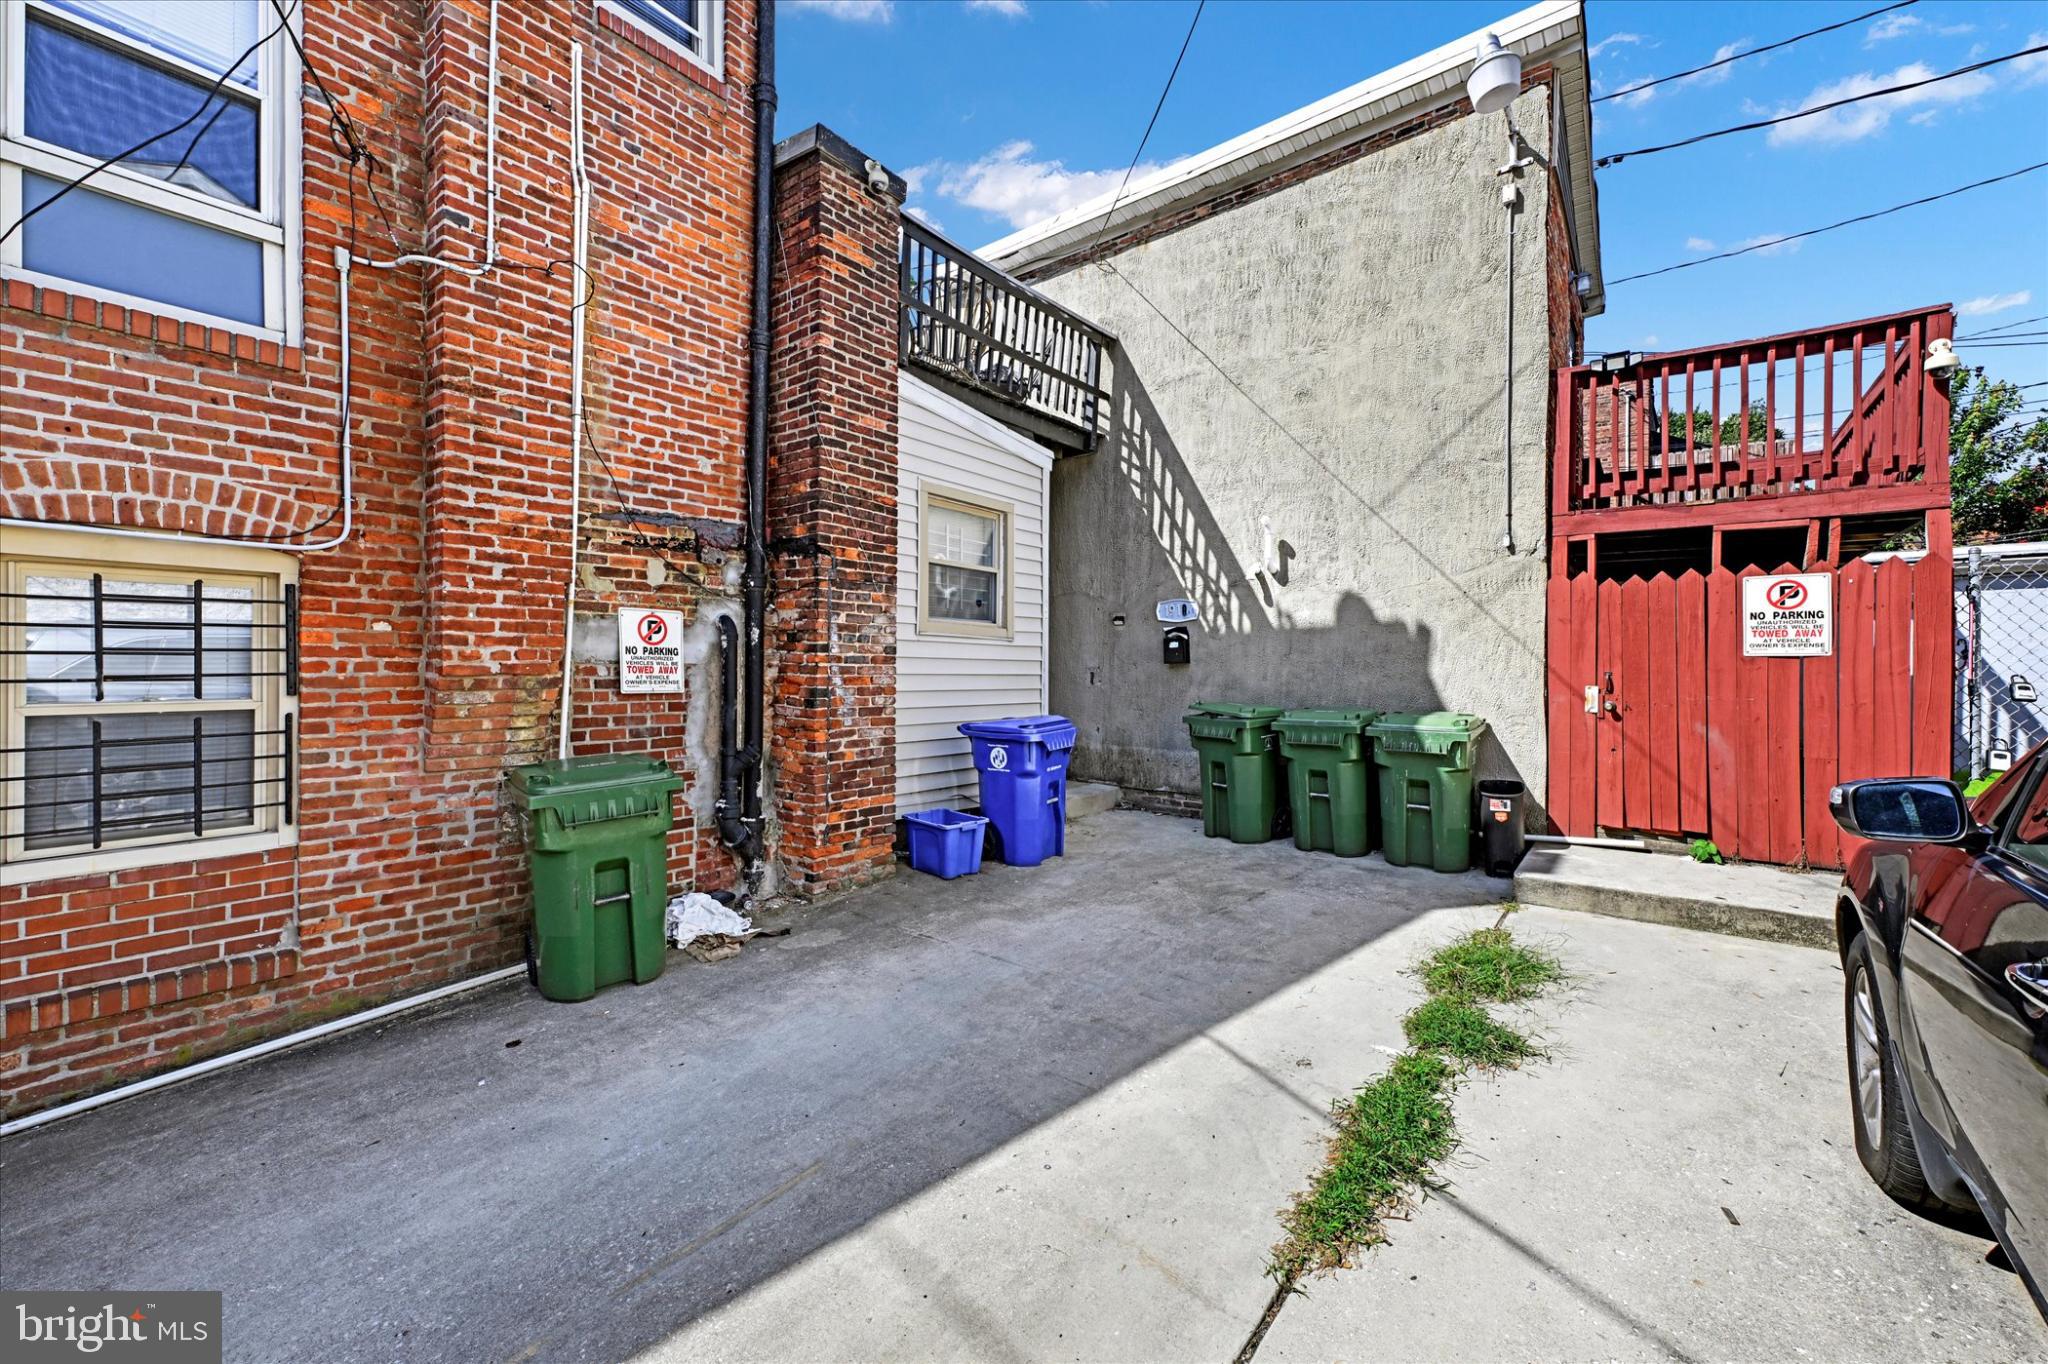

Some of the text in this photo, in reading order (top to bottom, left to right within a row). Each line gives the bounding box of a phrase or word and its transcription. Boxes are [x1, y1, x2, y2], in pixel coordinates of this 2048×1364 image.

[1750, 610, 1824, 620] NO PARKING
[625, 645, 679, 656] NO PARKING
[627, 666, 678, 674] TOWED AWAY
